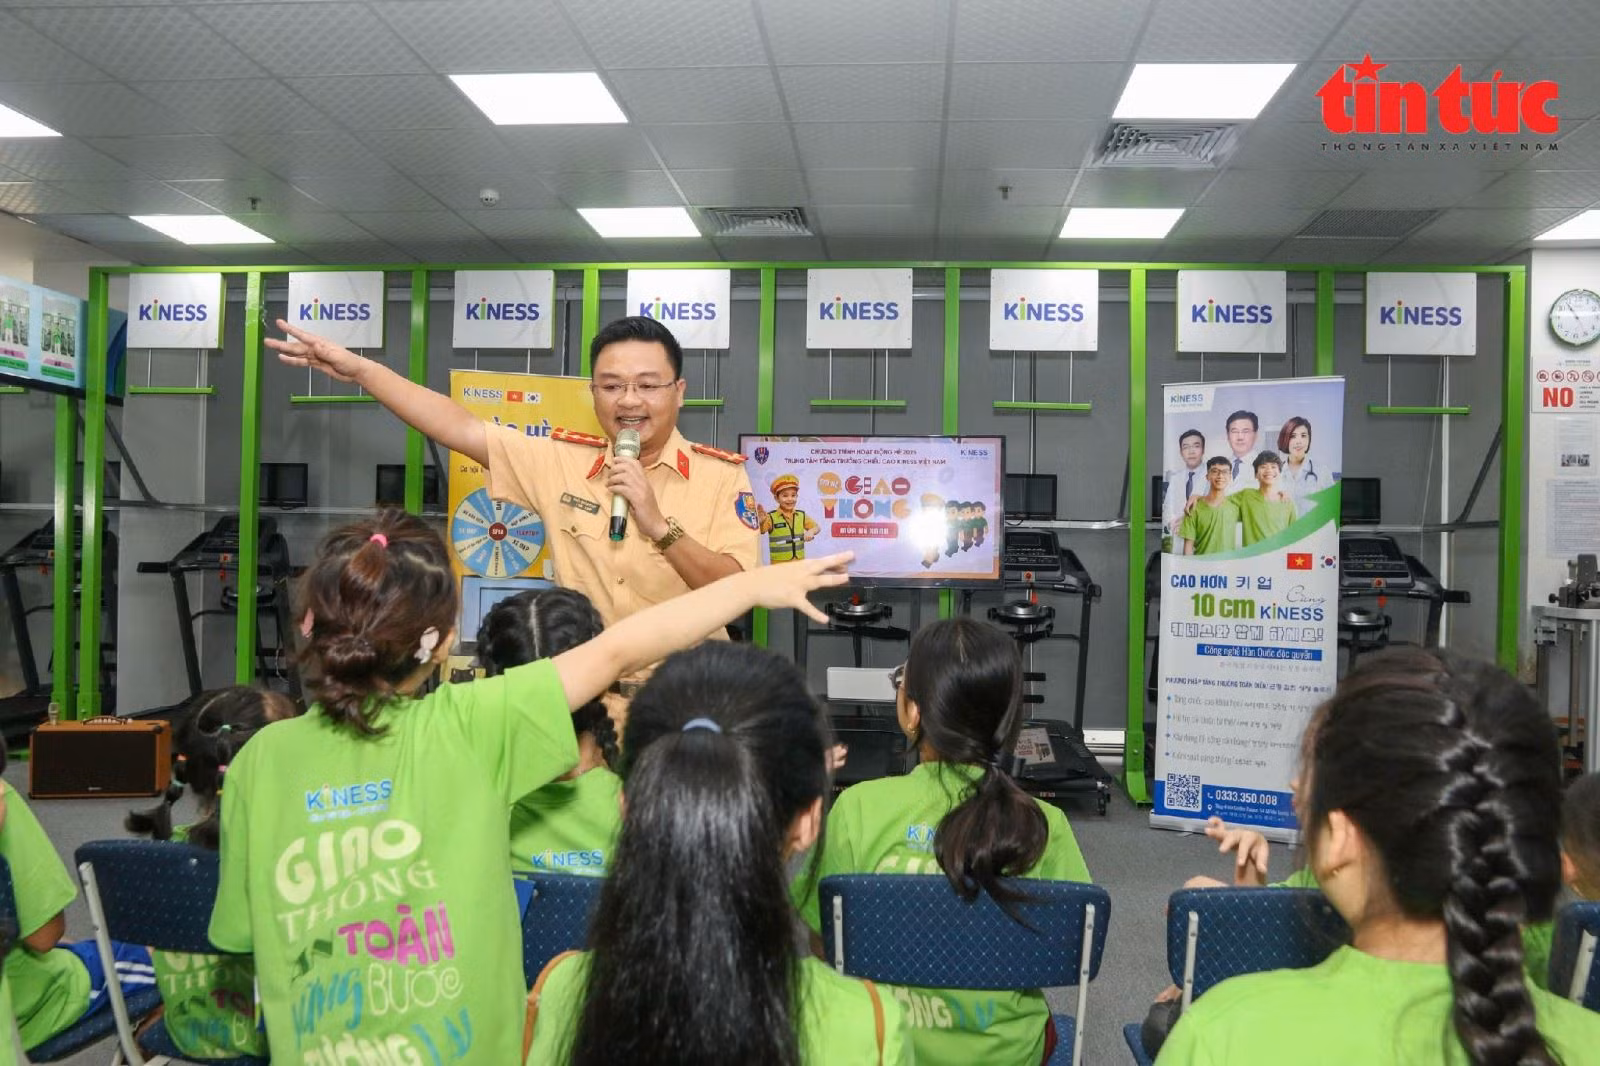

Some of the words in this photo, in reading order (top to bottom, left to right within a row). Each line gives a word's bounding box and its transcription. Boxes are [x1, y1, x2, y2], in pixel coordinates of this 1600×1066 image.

[1542, 387, 1574, 408] NO
[844, 475, 911, 496] GIAO
[1171, 574, 1196, 588] CAO
[1200, 574, 1228, 589] HƠN
[1191, 593, 1215, 618] 10
[1219, 597, 1256, 619] cm
[1215, 789, 1278, 806] 0333.350.008
